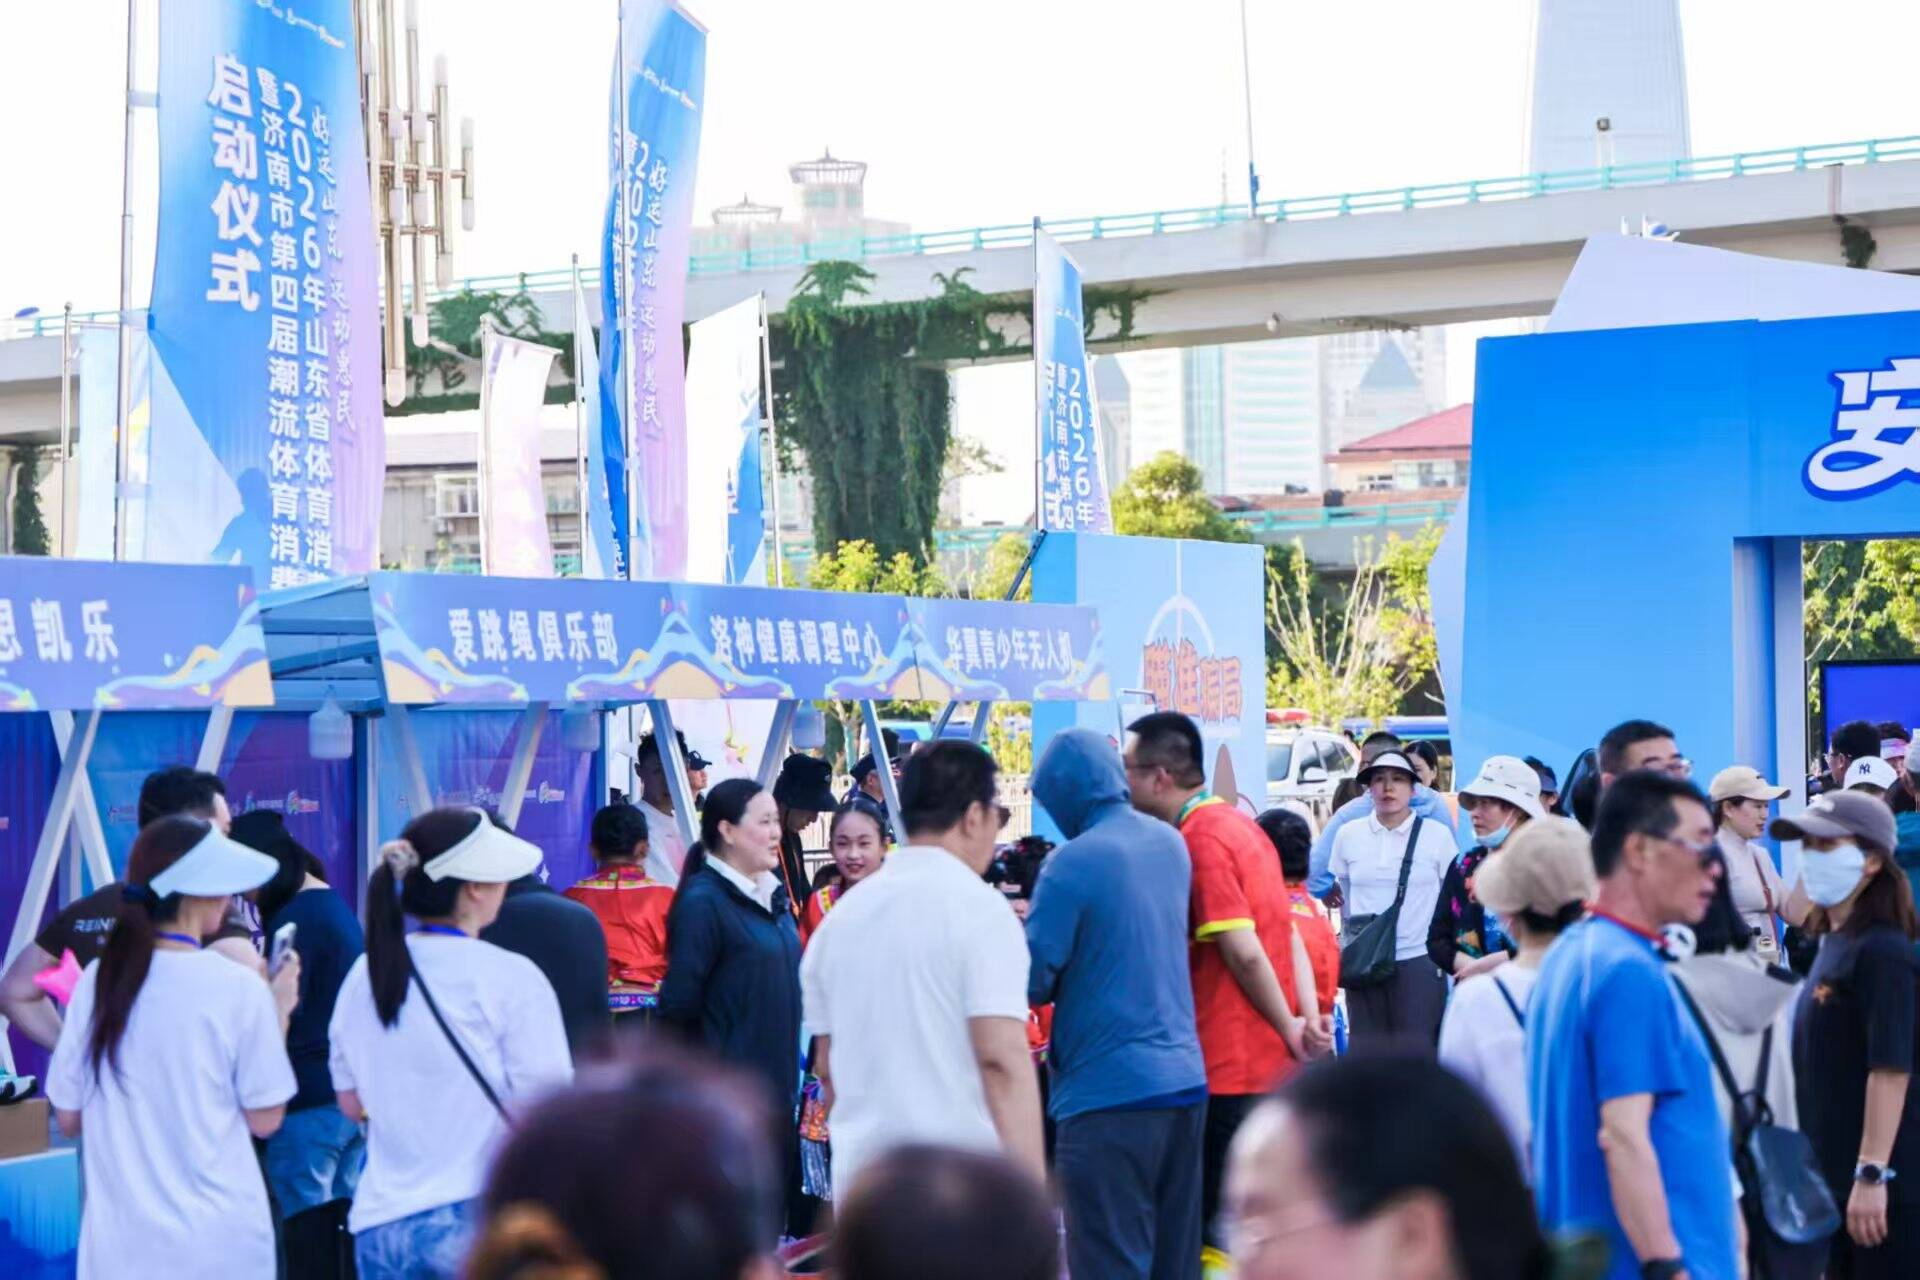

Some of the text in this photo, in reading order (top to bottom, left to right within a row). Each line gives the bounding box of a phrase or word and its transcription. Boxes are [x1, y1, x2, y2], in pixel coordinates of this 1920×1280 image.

[207, 53, 263, 312] 启动仪式
[284, 82, 334, 585] 2026年山东省体育消
[448, 608, 619, 667] 爱跳绳俱乐部
[709, 614, 884, 670] 洛神健康调理中心
